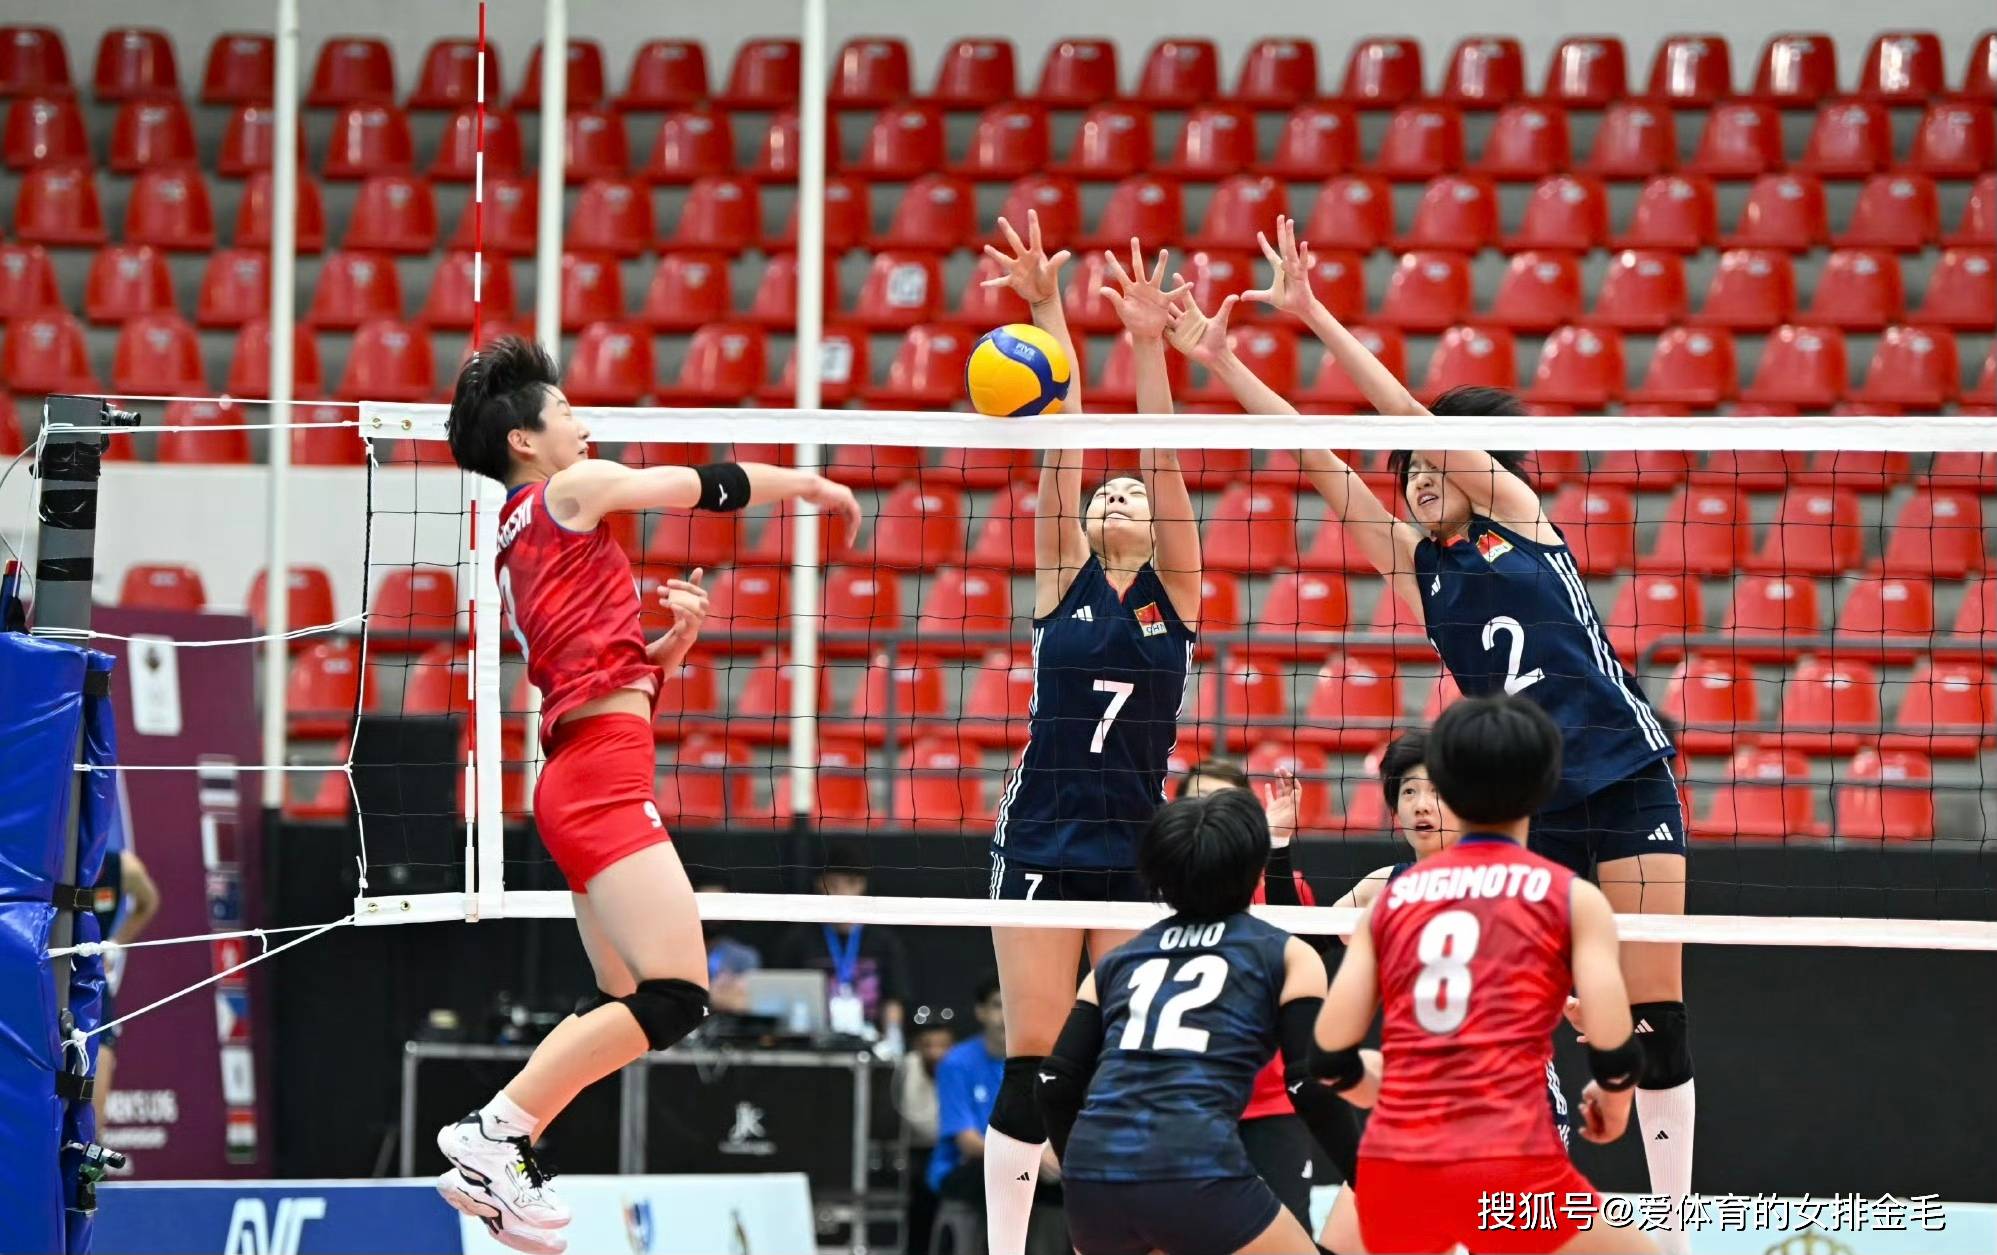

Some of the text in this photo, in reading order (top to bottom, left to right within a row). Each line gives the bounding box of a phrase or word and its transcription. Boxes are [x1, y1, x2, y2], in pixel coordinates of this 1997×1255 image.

[1481, 615, 1546, 697] 2
[1089, 679, 1135, 754] 7
[643, 800, 663, 829] 9
[1024, 873, 1043, 901] 7
[1387, 863, 1552, 911] SUGIMOTO
[1159, 921, 1226, 951] ONO
[1412, 909, 1480, 1036] 8
[1118, 954, 1229, 1054] 12
